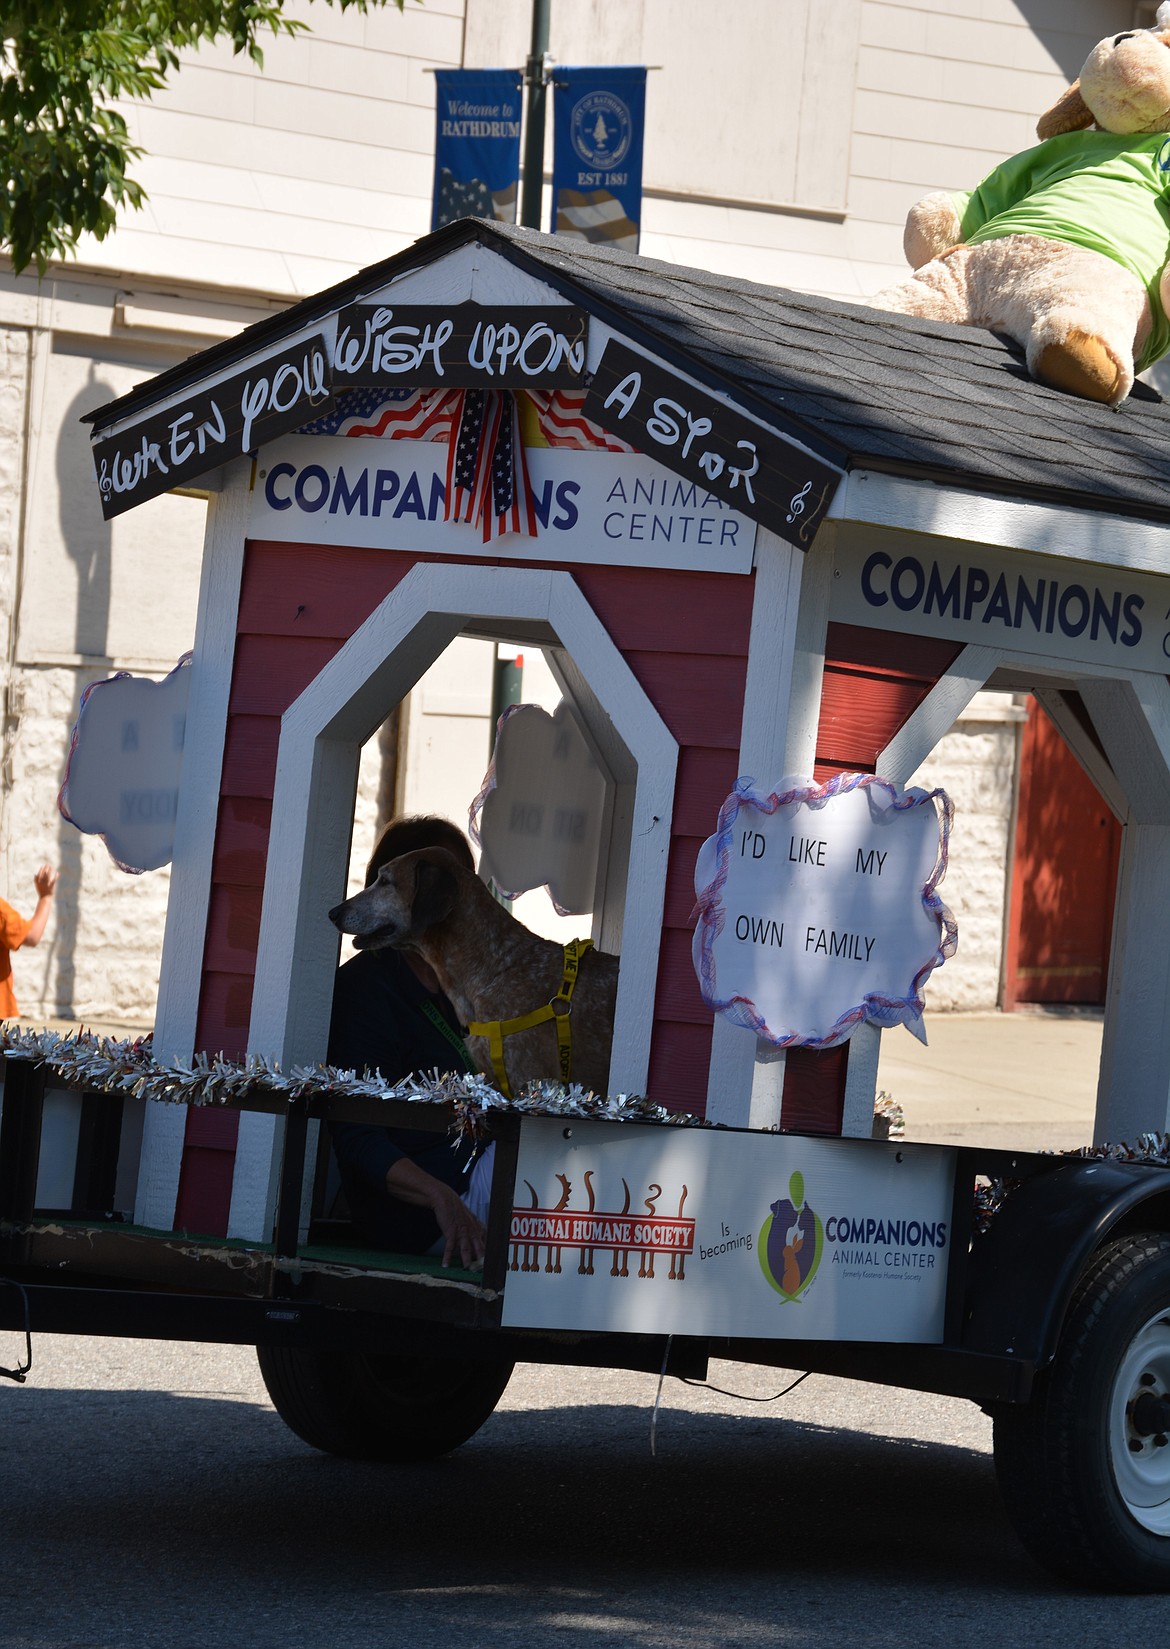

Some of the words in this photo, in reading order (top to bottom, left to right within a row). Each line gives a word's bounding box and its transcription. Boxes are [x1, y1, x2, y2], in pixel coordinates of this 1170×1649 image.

[448, 101, 501, 118] Welcome
[502, 103, 513, 118] to
[441, 120, 520, 138] RATHDRUM
[577, 172, 602, 186] EST
[604, 172, 628, 186] 1881
[467, 321, 585, 376] UPON
[241, 352, 329, 453] YOU
[604, 371, 642, 419] A
[606, 477, 738, 510] ANIMA
[603, 512, 740, 547] CENTER
[861, 551, 1145, 647] COMPANIONS
[741, 830, 766, 859] I'D
[789, 836, 827, 866] LIKE
[855, 848, 887, 876] MY
[735, 915, 784, 948] OWN
[805, 926, 876, 962] FAMILY
[511, 1217, 569, 1240] OOTENAI
[572, 1220, 632, 1243] HUMANE
[633, 1223, 692, 1246] SOCIETY
[721, 1221, 730, 1237] Is
[825, 1216, 947, 1248] COMPANIONS
[700, 1232, 753, 1260] becoming
[832, 1250, 880, 1266] ANIMAL
[884, 1252, 935, 1268] CENTER
